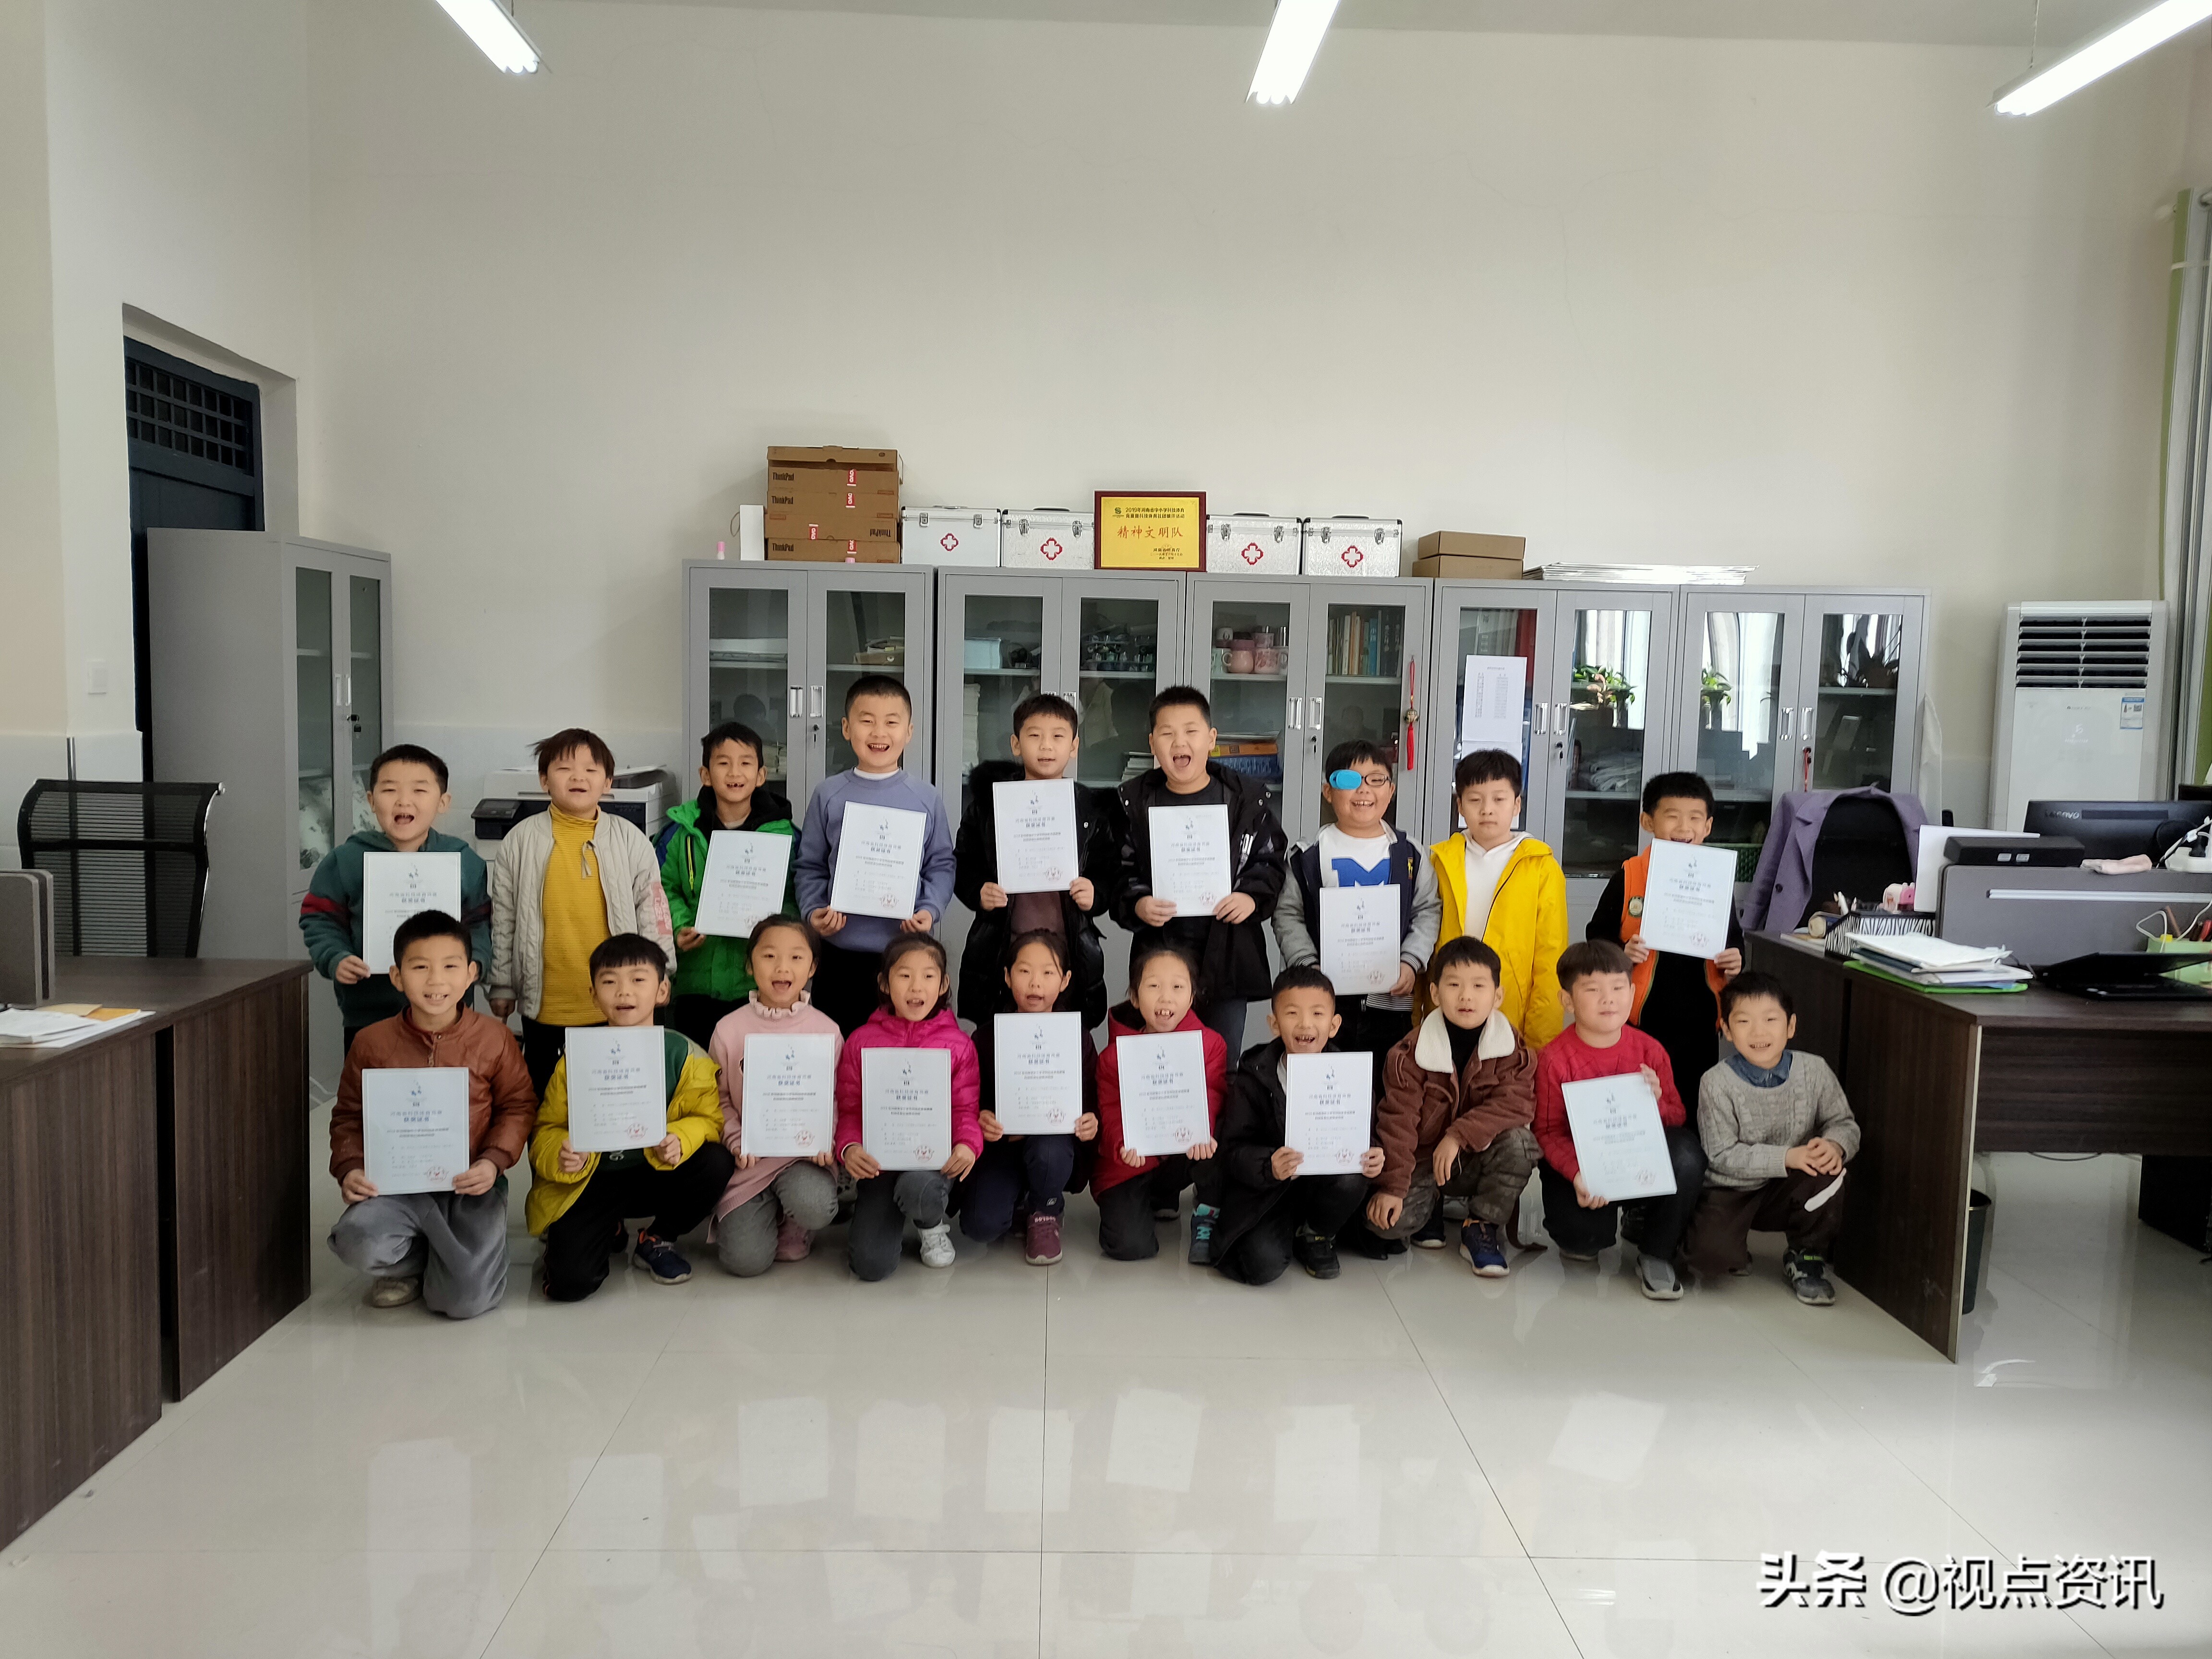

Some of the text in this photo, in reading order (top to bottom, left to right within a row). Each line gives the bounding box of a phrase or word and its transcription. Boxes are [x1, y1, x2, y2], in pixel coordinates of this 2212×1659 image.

[772, 472, 794, 481] ThinkPad
[771, 495, 793, 505] ThinkPad
[869, 529, 891, 537] ThinkPad
[1117, 525, 1183, 539] 精神文明队
[772, 543, 794, 552] ThinkPad
